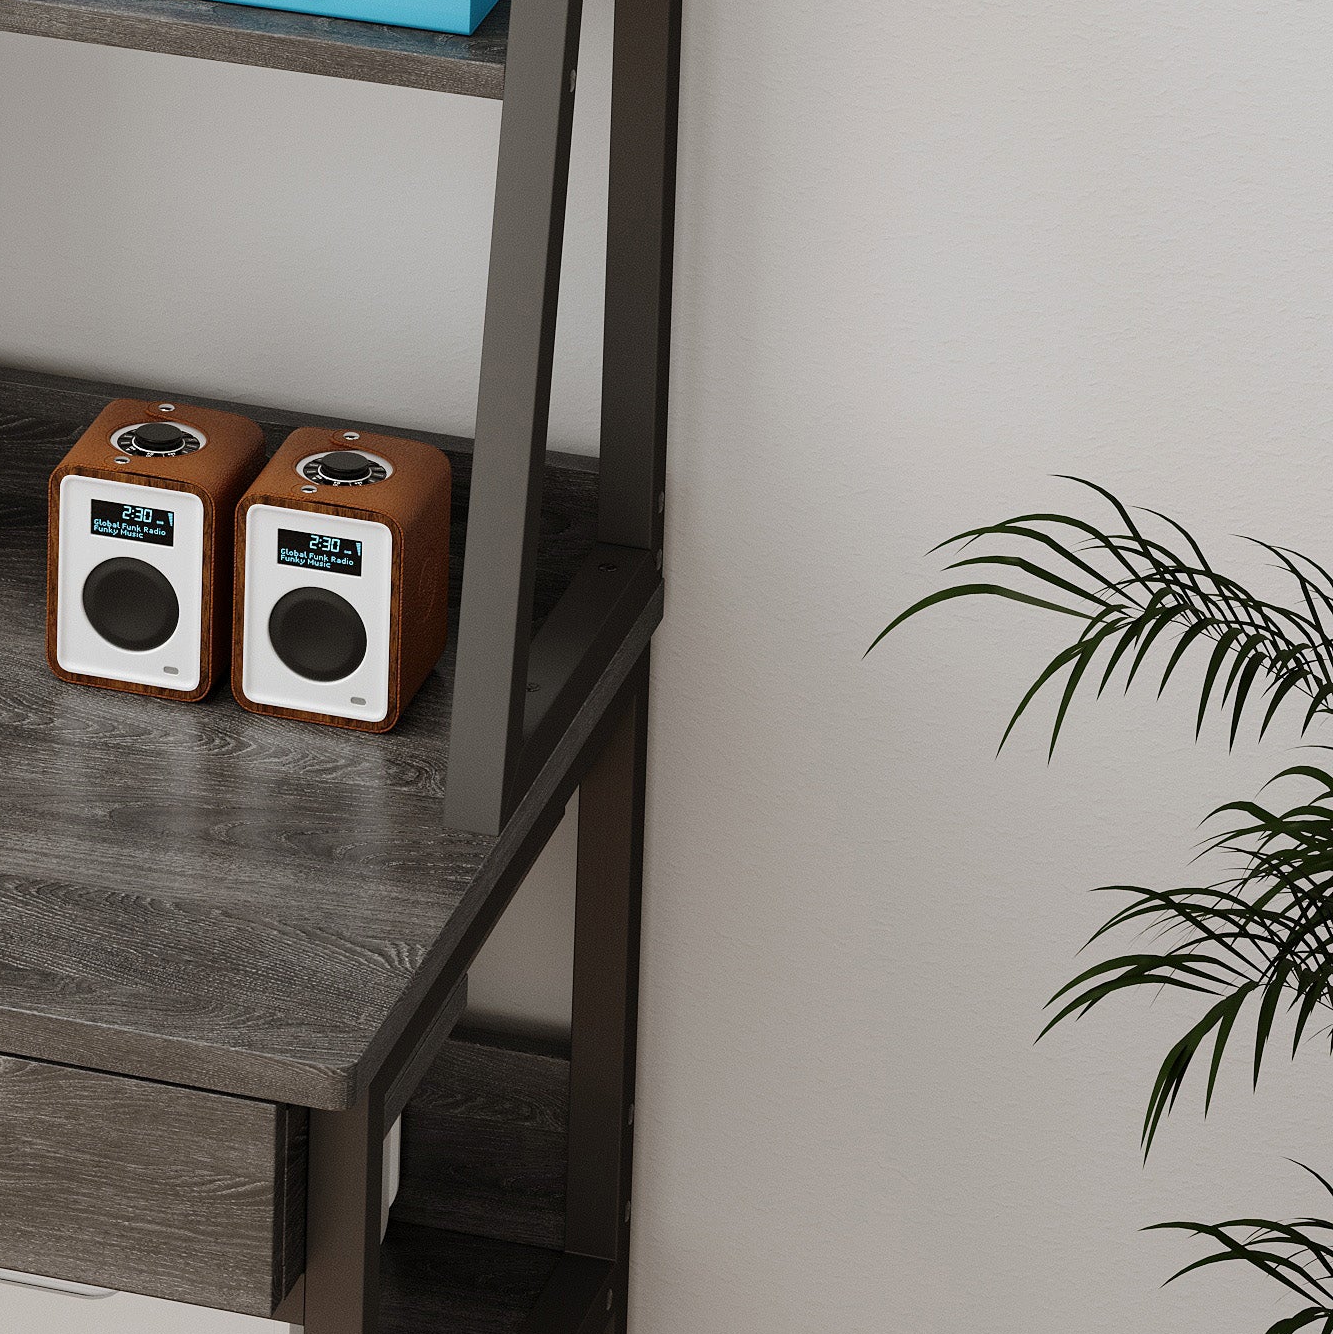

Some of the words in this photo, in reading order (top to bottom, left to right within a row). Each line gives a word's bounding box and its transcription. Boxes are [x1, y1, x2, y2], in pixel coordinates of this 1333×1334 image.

[122, 505, 153, 523] 2:30
[93, 518, 120, 529] Global
[121, 523, 141, 532] Funk
[143, 526, 166, 536] Radio
[93, 524, 119, 536] Funky
[120, 529, 144, 539] Music
[309, 535, 341, 553] 2:30
[280, 548, 307, 559] Global
[308, 552, 329, 562] Funk
[330, 556, 354, 566] Radio
[280, 554, 306, 565] Funky
[307, 558, 331, 569] Music
